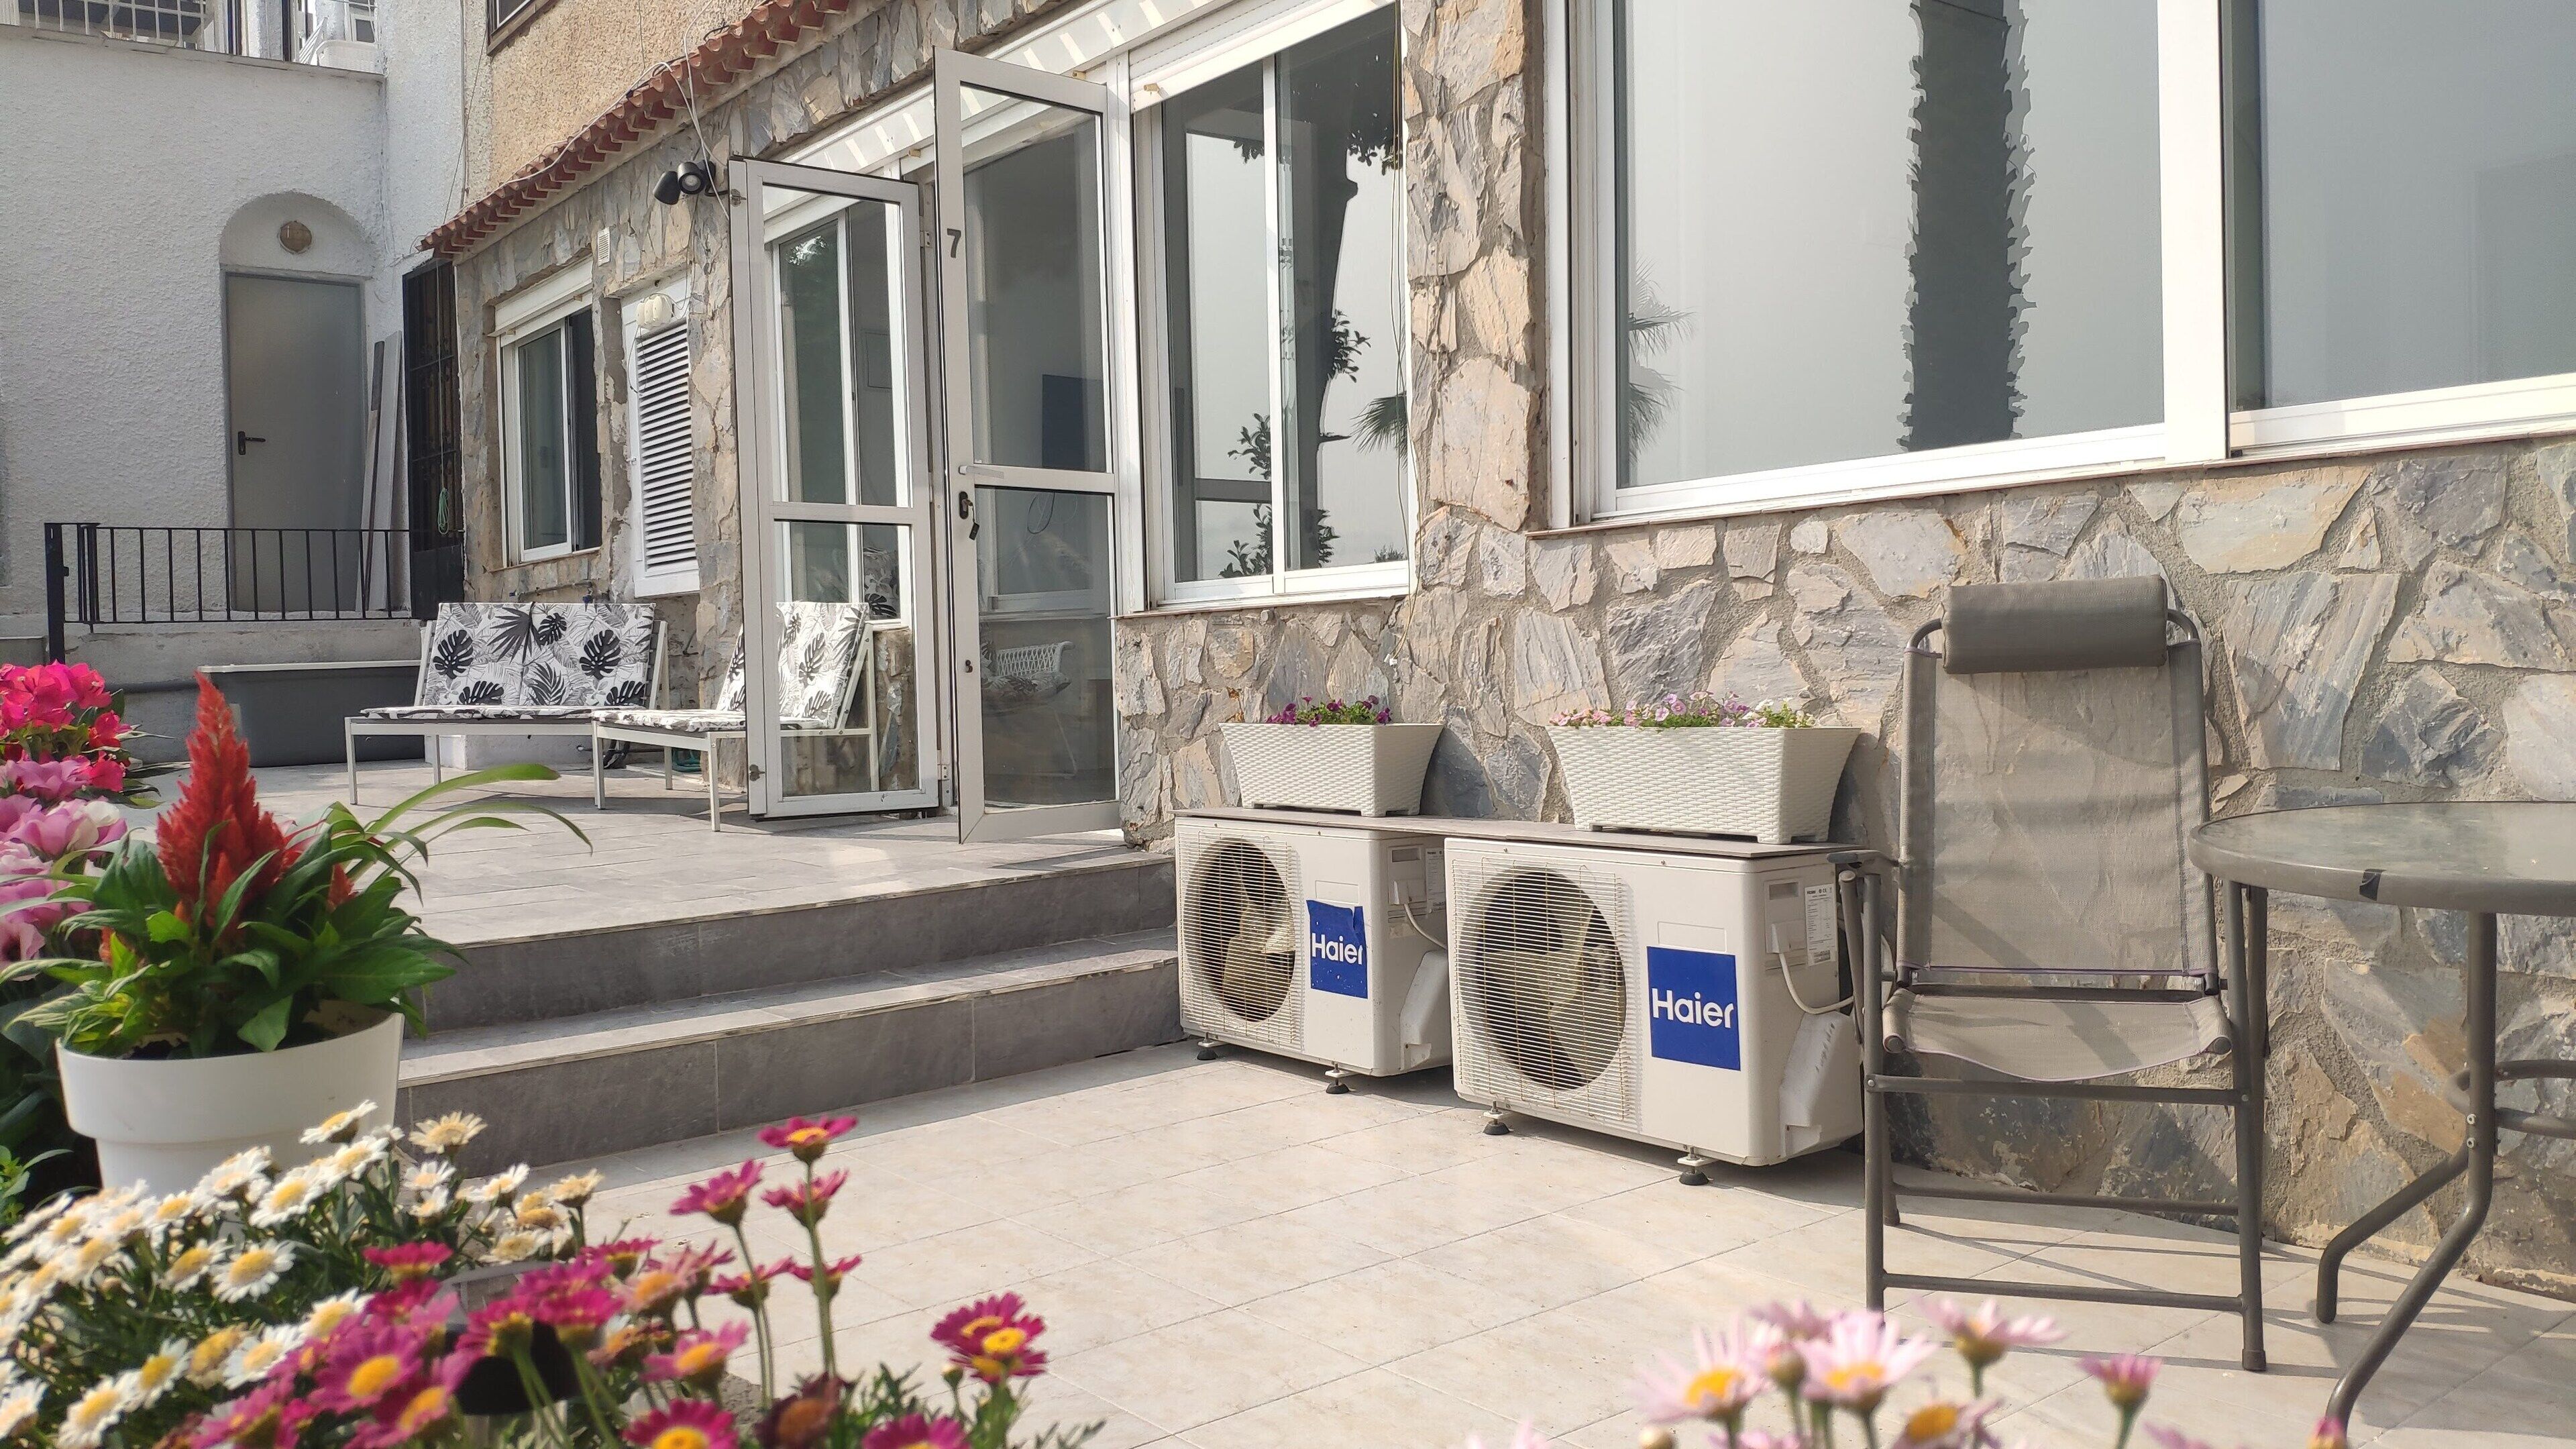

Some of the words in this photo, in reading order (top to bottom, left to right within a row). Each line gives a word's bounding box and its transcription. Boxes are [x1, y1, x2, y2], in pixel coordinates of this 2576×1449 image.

[947, 228, 961, 259] 7
[1311, 932, 1363, 965] Haier
[1652, 987, 1734, 1028] Haier
